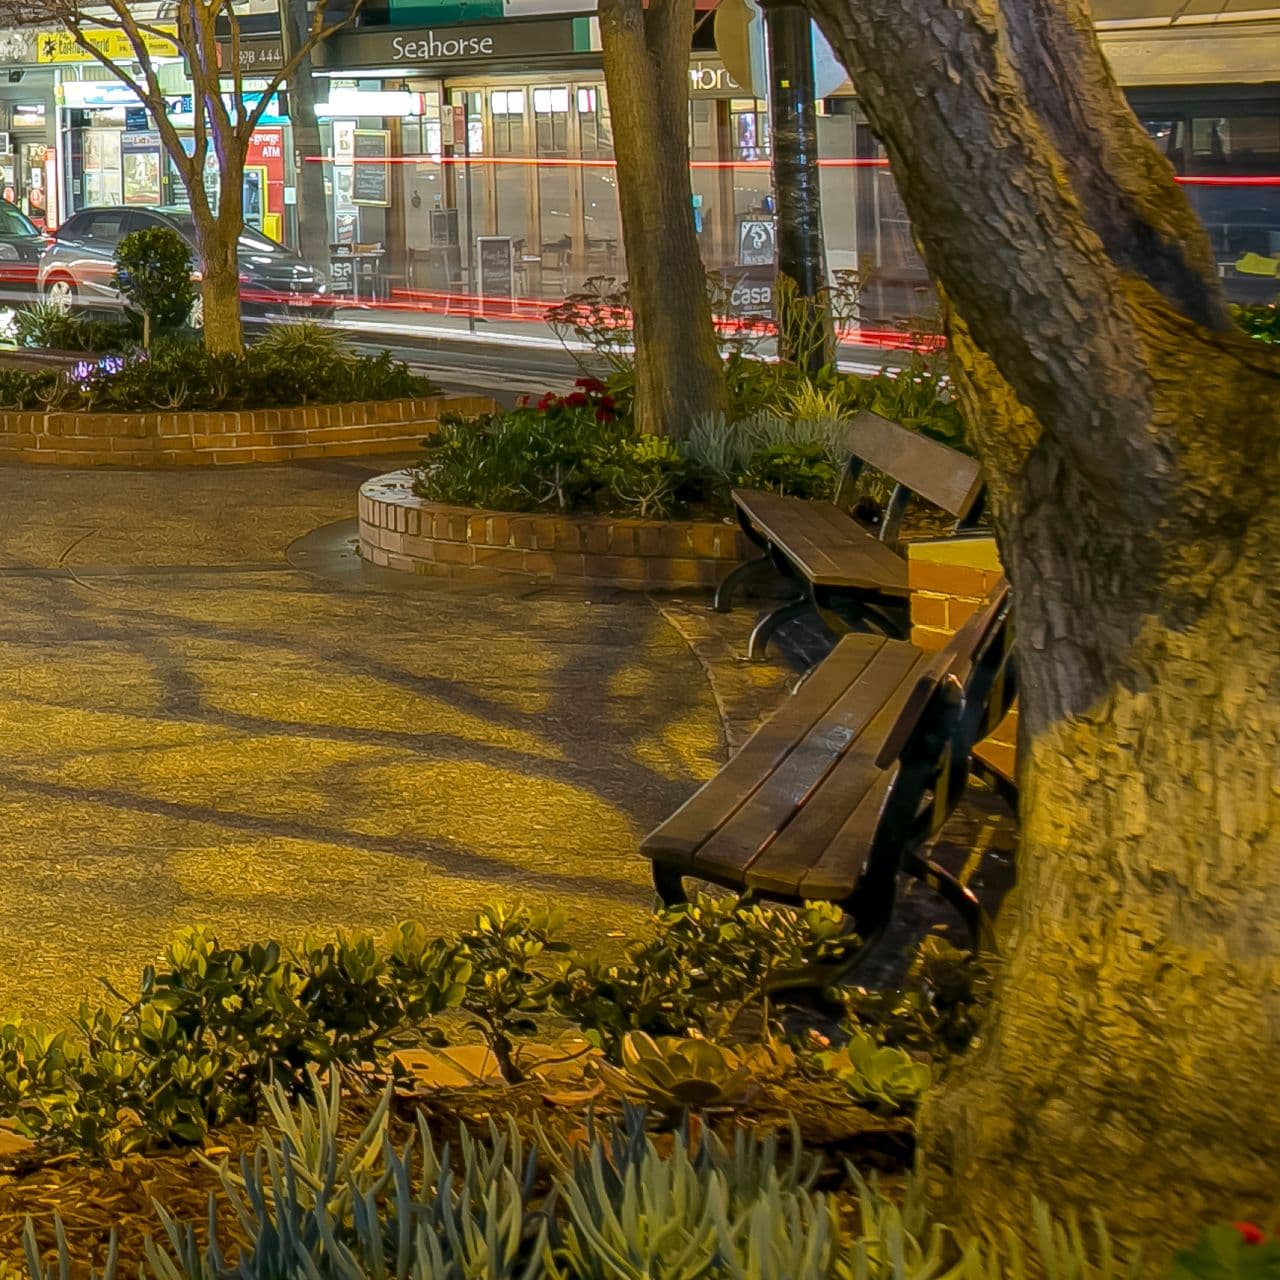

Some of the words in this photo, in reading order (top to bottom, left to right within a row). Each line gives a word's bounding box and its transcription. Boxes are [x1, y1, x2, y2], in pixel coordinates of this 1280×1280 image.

[392, 30, 494, 60] Seahorse
[262, 145, 281, 158] ATM
[730, 286, 771, 307] casa
